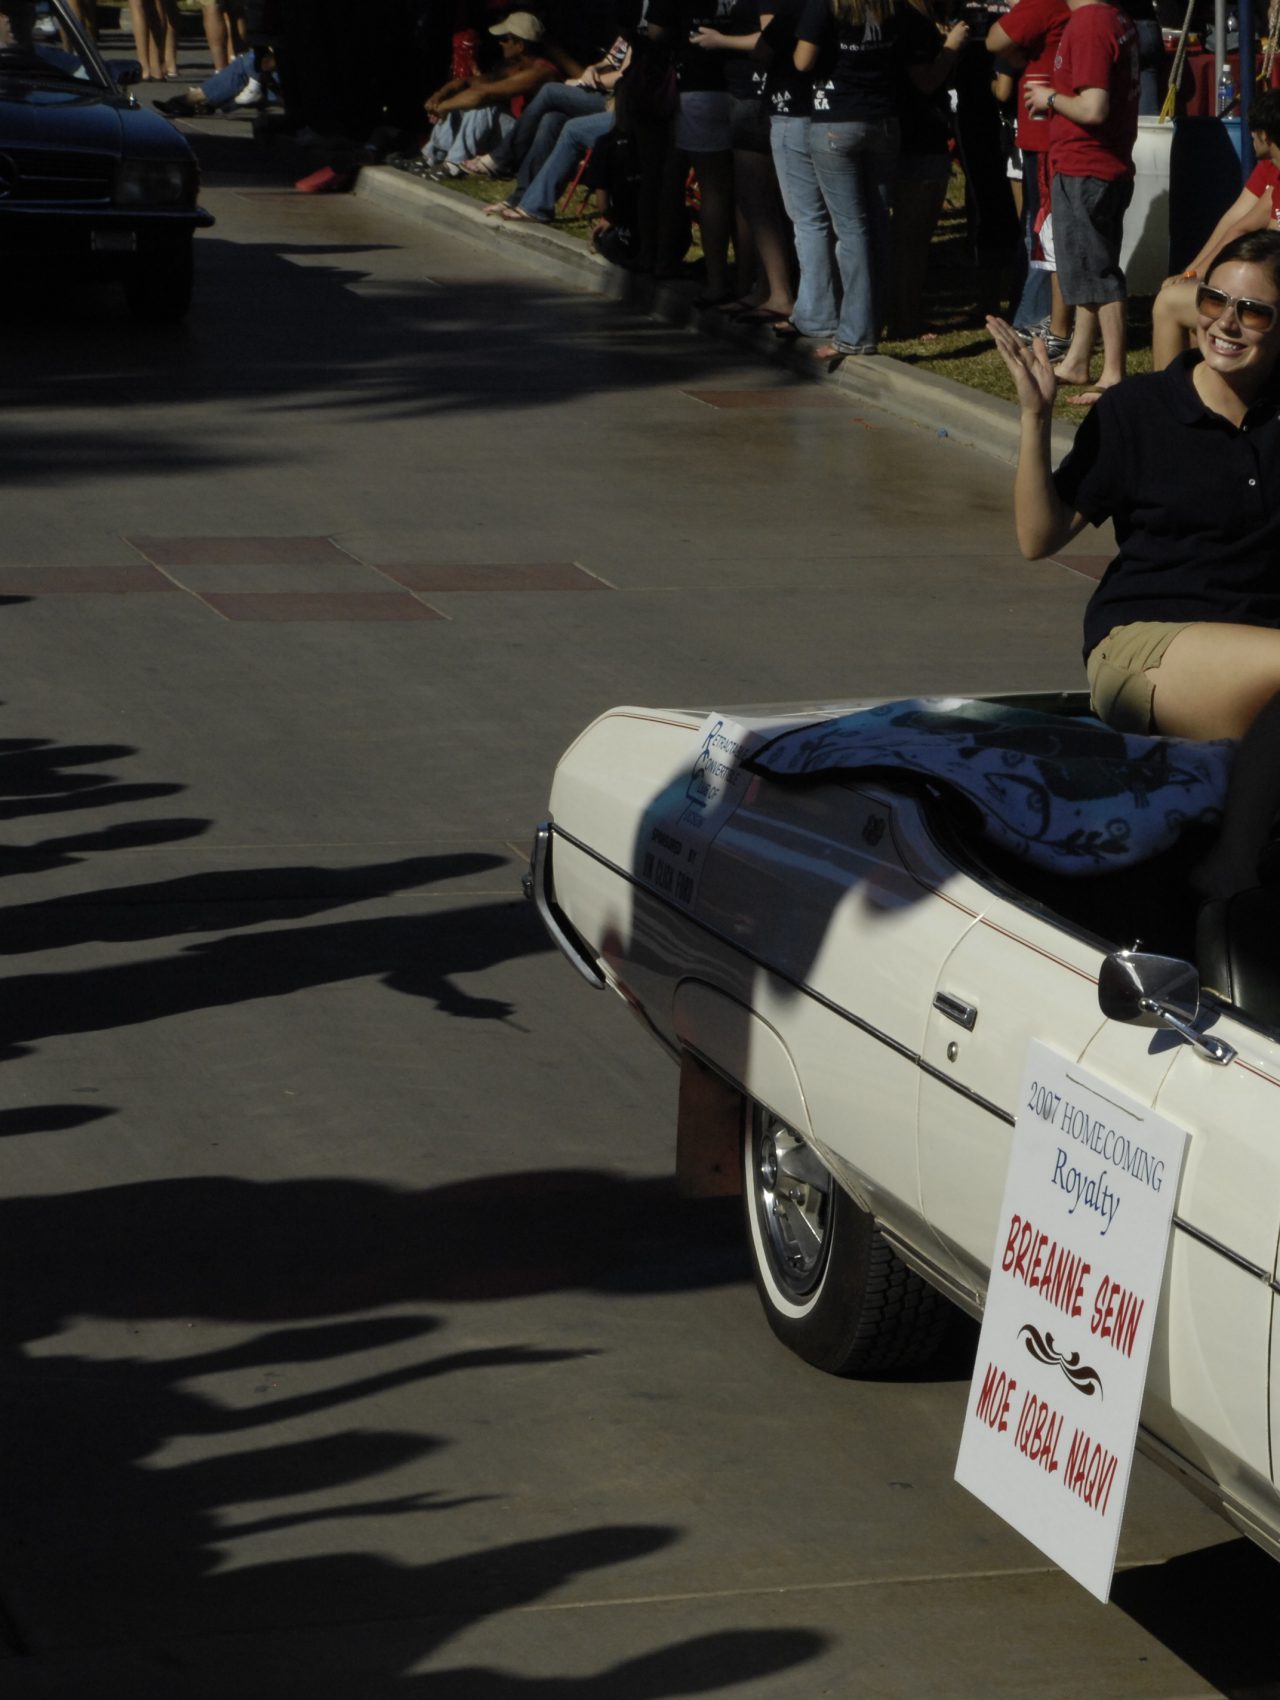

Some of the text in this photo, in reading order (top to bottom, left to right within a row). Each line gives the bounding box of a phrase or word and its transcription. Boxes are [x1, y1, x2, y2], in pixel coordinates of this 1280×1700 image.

[1027, 1081, 1165, 1193] 2007 HOMECOMING
[1051, 1148, 1120, 1236] Royalty
[1002, 1214, 1144, 1358] BRIEANNE SENN
[976, 1362, 1118, 1517] MOE IQBAL NAQVI
